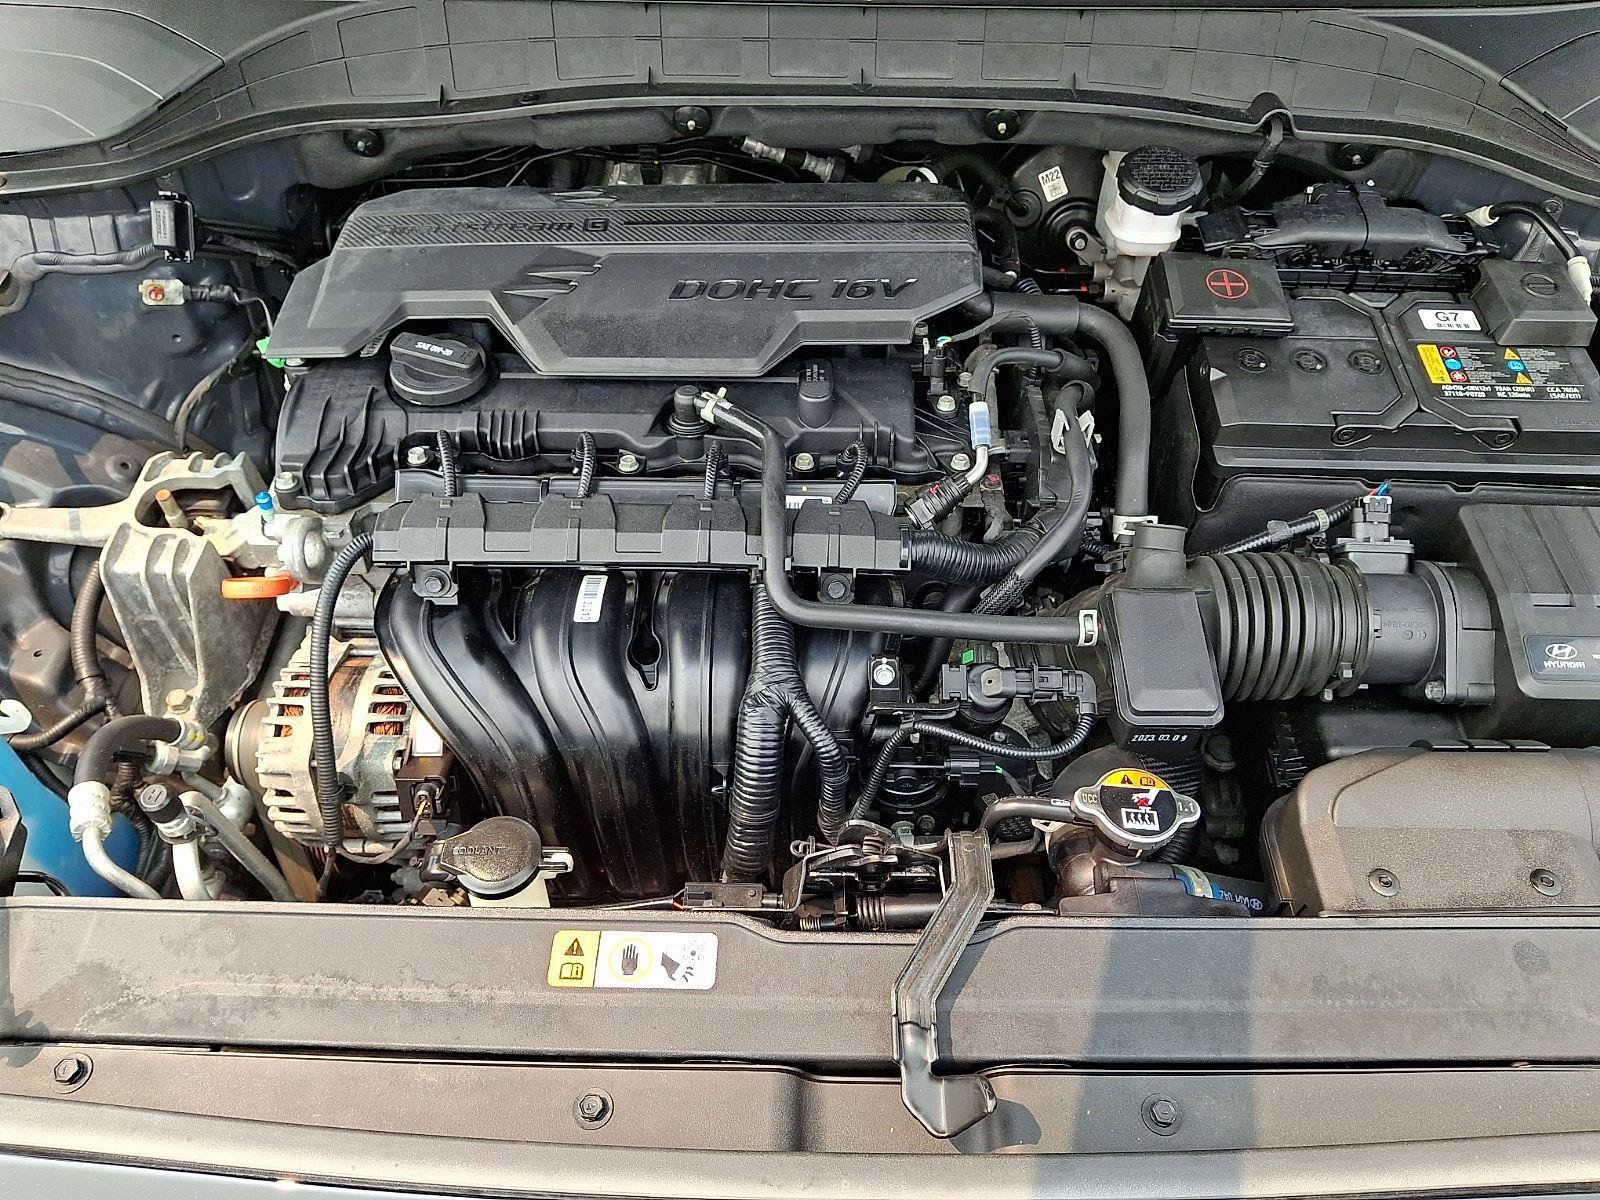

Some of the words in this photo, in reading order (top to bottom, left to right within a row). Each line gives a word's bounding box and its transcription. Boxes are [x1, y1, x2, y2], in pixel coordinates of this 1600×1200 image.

[1041, 169, 1061, 186] M22
[667, 278, 820, 300] DOHC
[830, 278, 918, 300] 16V
[1435, 311, 1459, 322] G7
[1543, 660, 1586, 669] HYUNDAI
[452, 846, 503, 856] COOLANT
